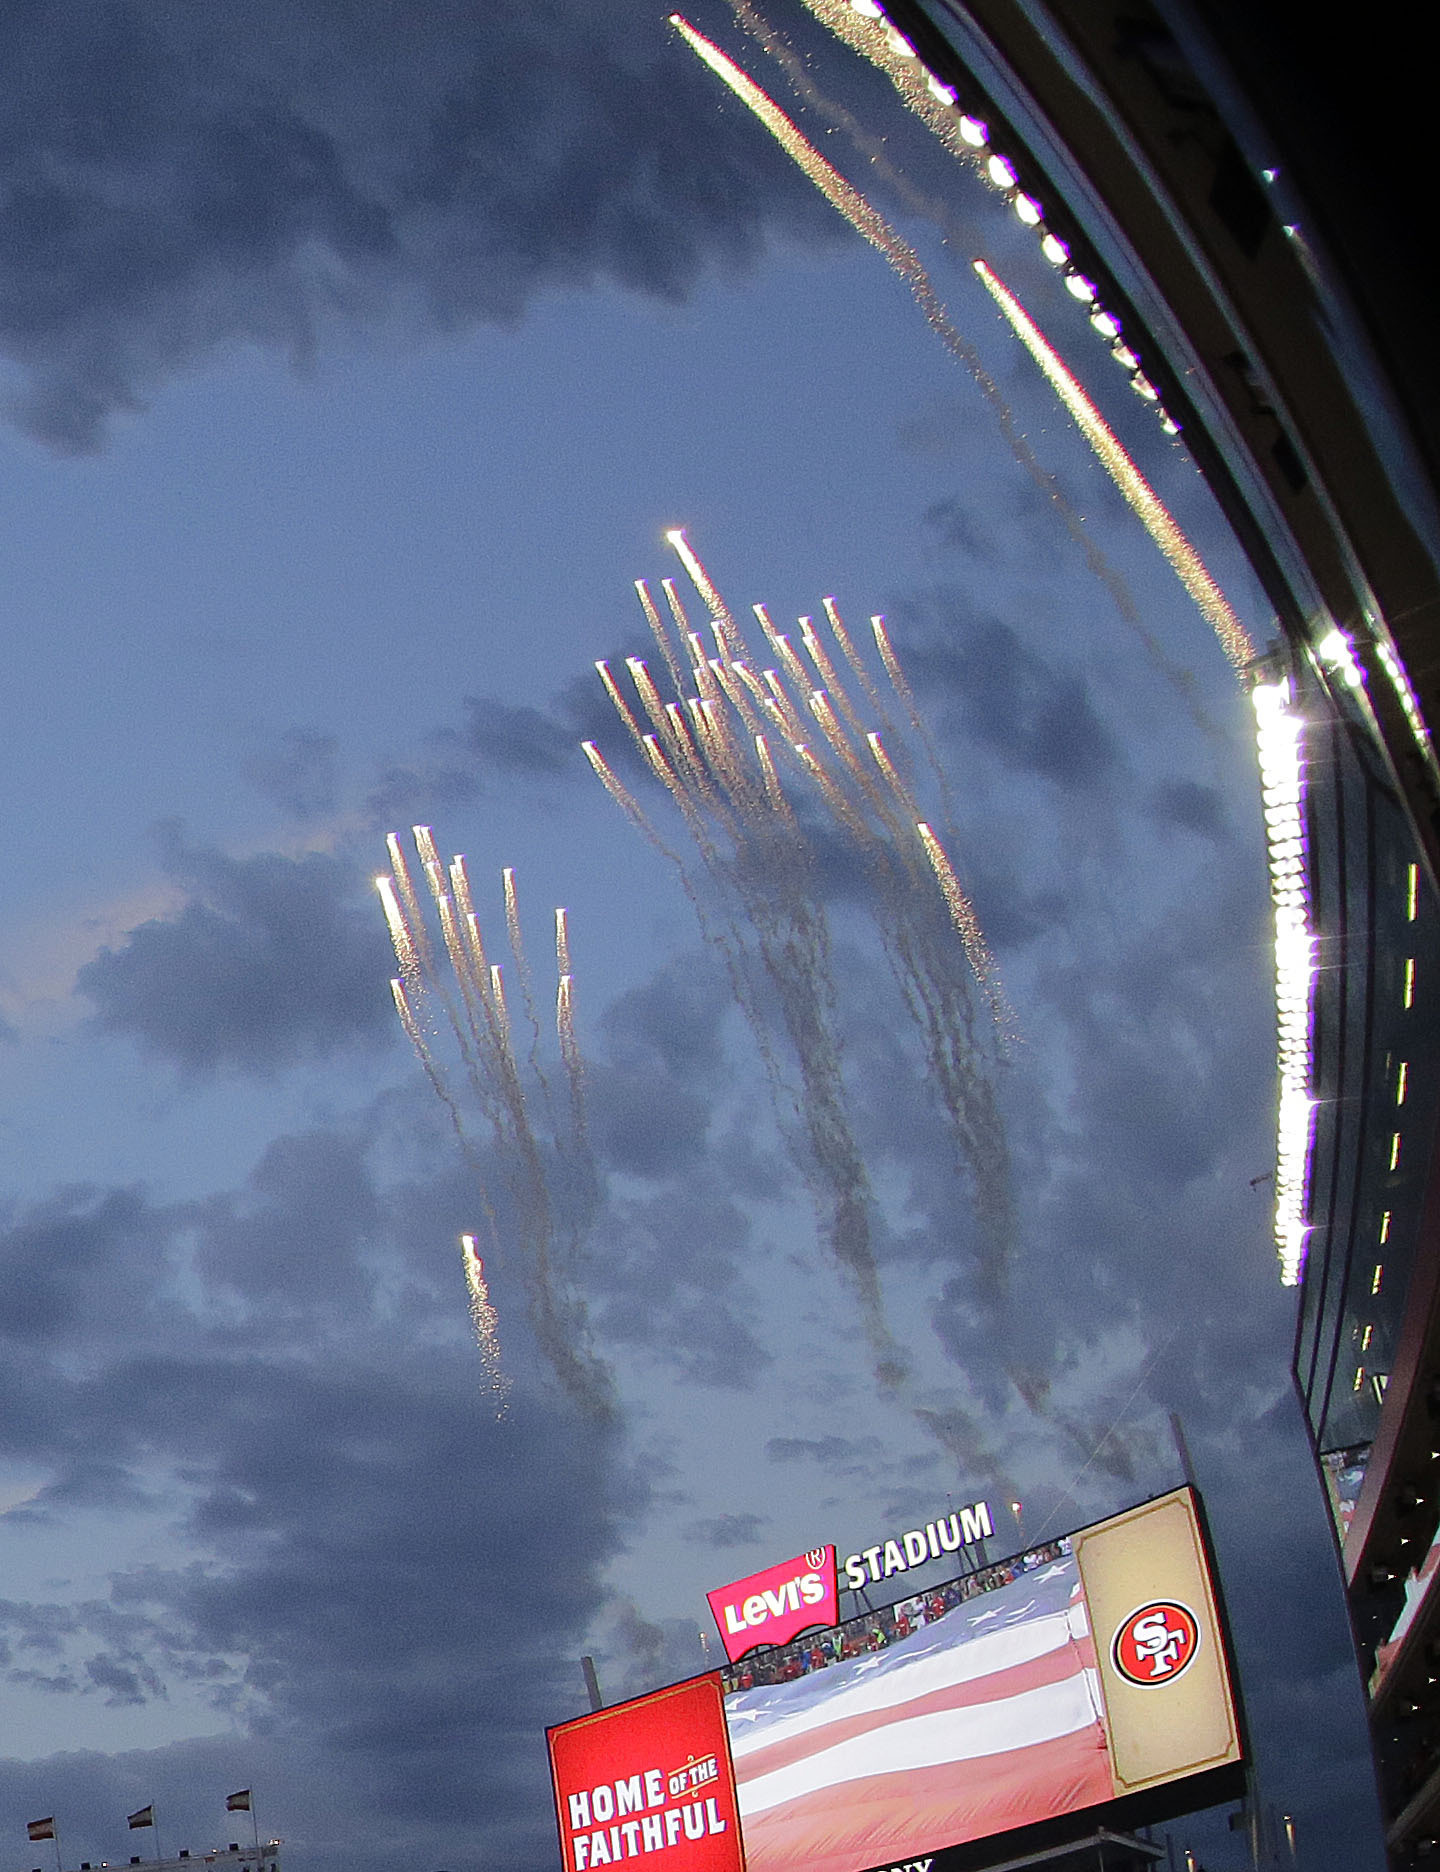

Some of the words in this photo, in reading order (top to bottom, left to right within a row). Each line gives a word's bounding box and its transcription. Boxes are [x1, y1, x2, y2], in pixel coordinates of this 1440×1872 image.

[843, 1502, 995, 1591] STADIUM
[568, 1768, 666, 1832] HOME
[667, 1772, 689, 1798] OF
[689, 1759, 718, 1787] THE
[572, 1798, 727, 1872] FAITHFUL
